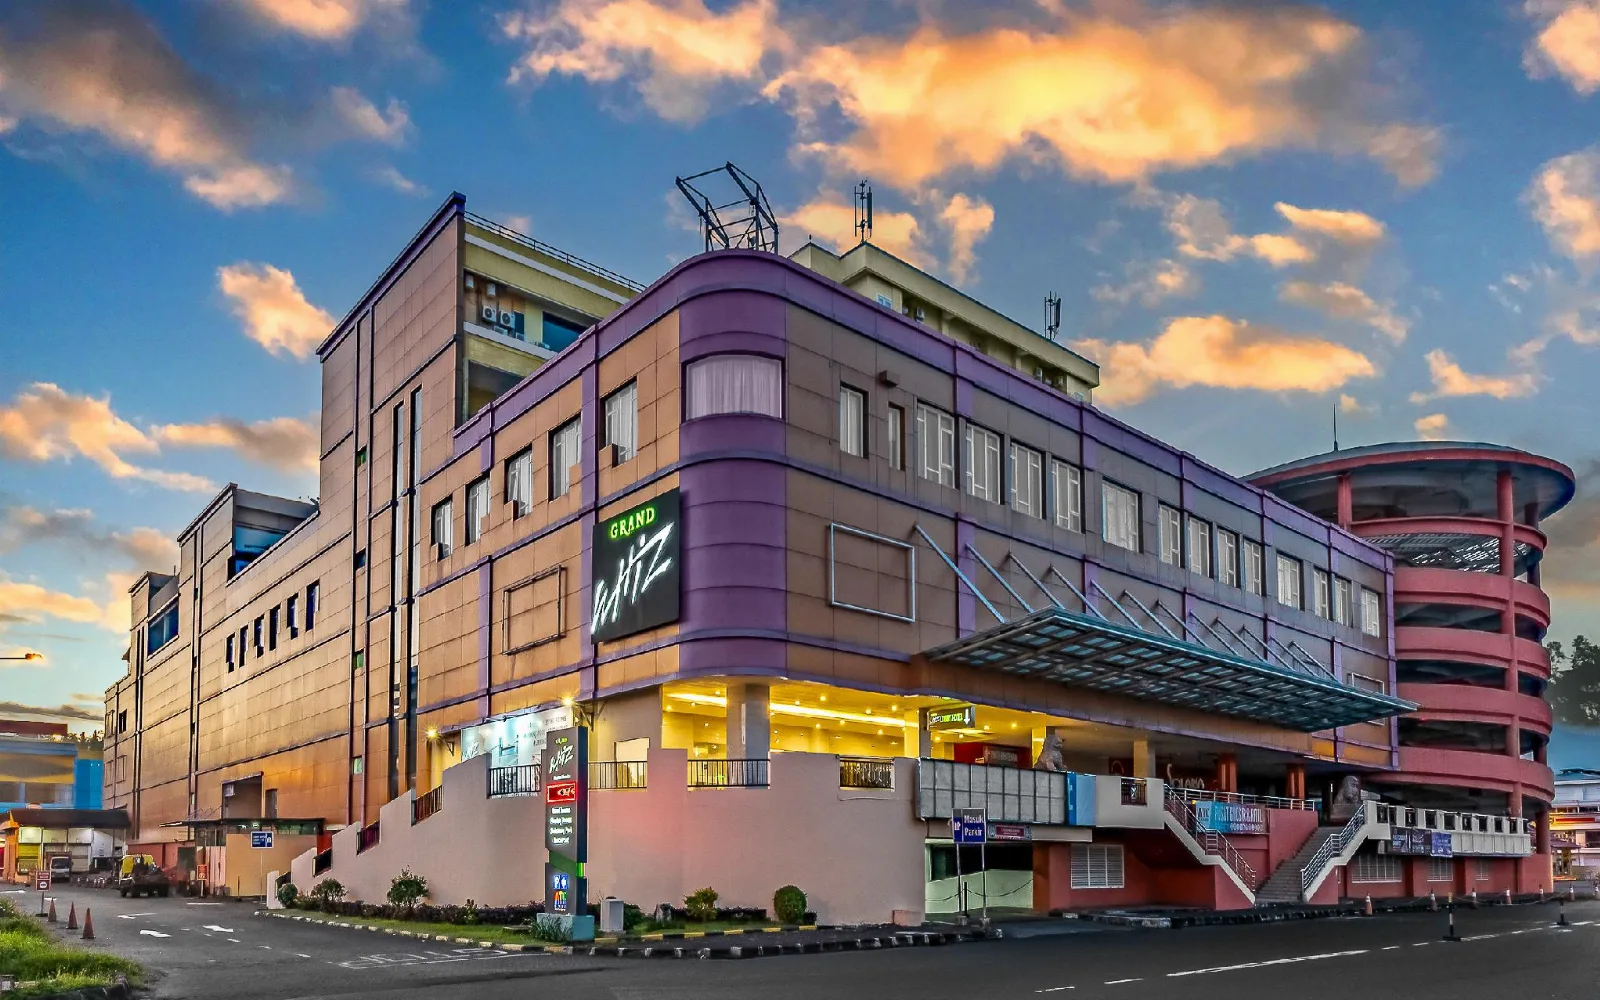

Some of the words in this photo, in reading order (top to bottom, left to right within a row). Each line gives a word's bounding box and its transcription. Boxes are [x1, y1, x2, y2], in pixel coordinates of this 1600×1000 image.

[610, 507, 655, 539] GRAND
[963, 815, 983, 824] Masuk
[964, 827, 983, 837] Parkir
